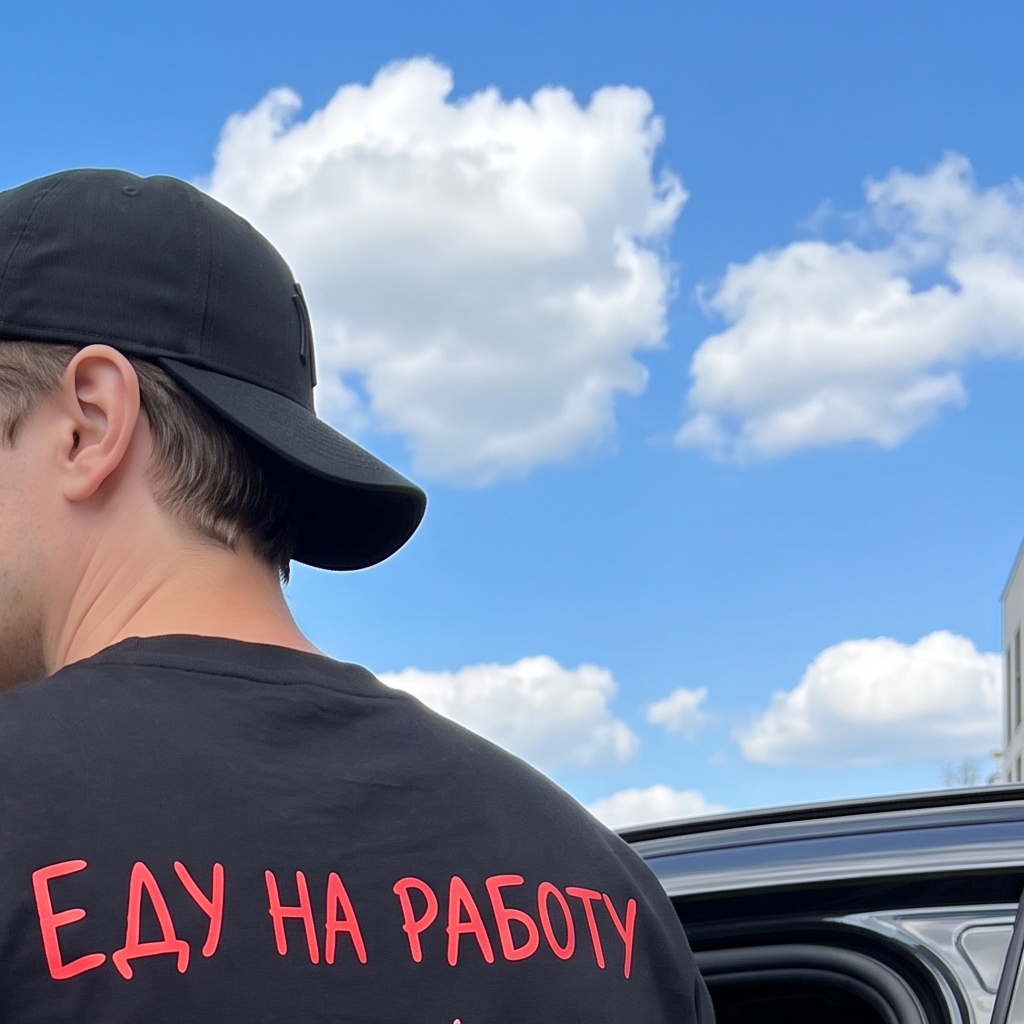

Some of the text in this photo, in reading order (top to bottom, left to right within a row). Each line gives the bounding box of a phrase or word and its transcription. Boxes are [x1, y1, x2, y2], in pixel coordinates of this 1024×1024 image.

[32, 861, 636, 979] ЕДУ НА РАБОТУ
